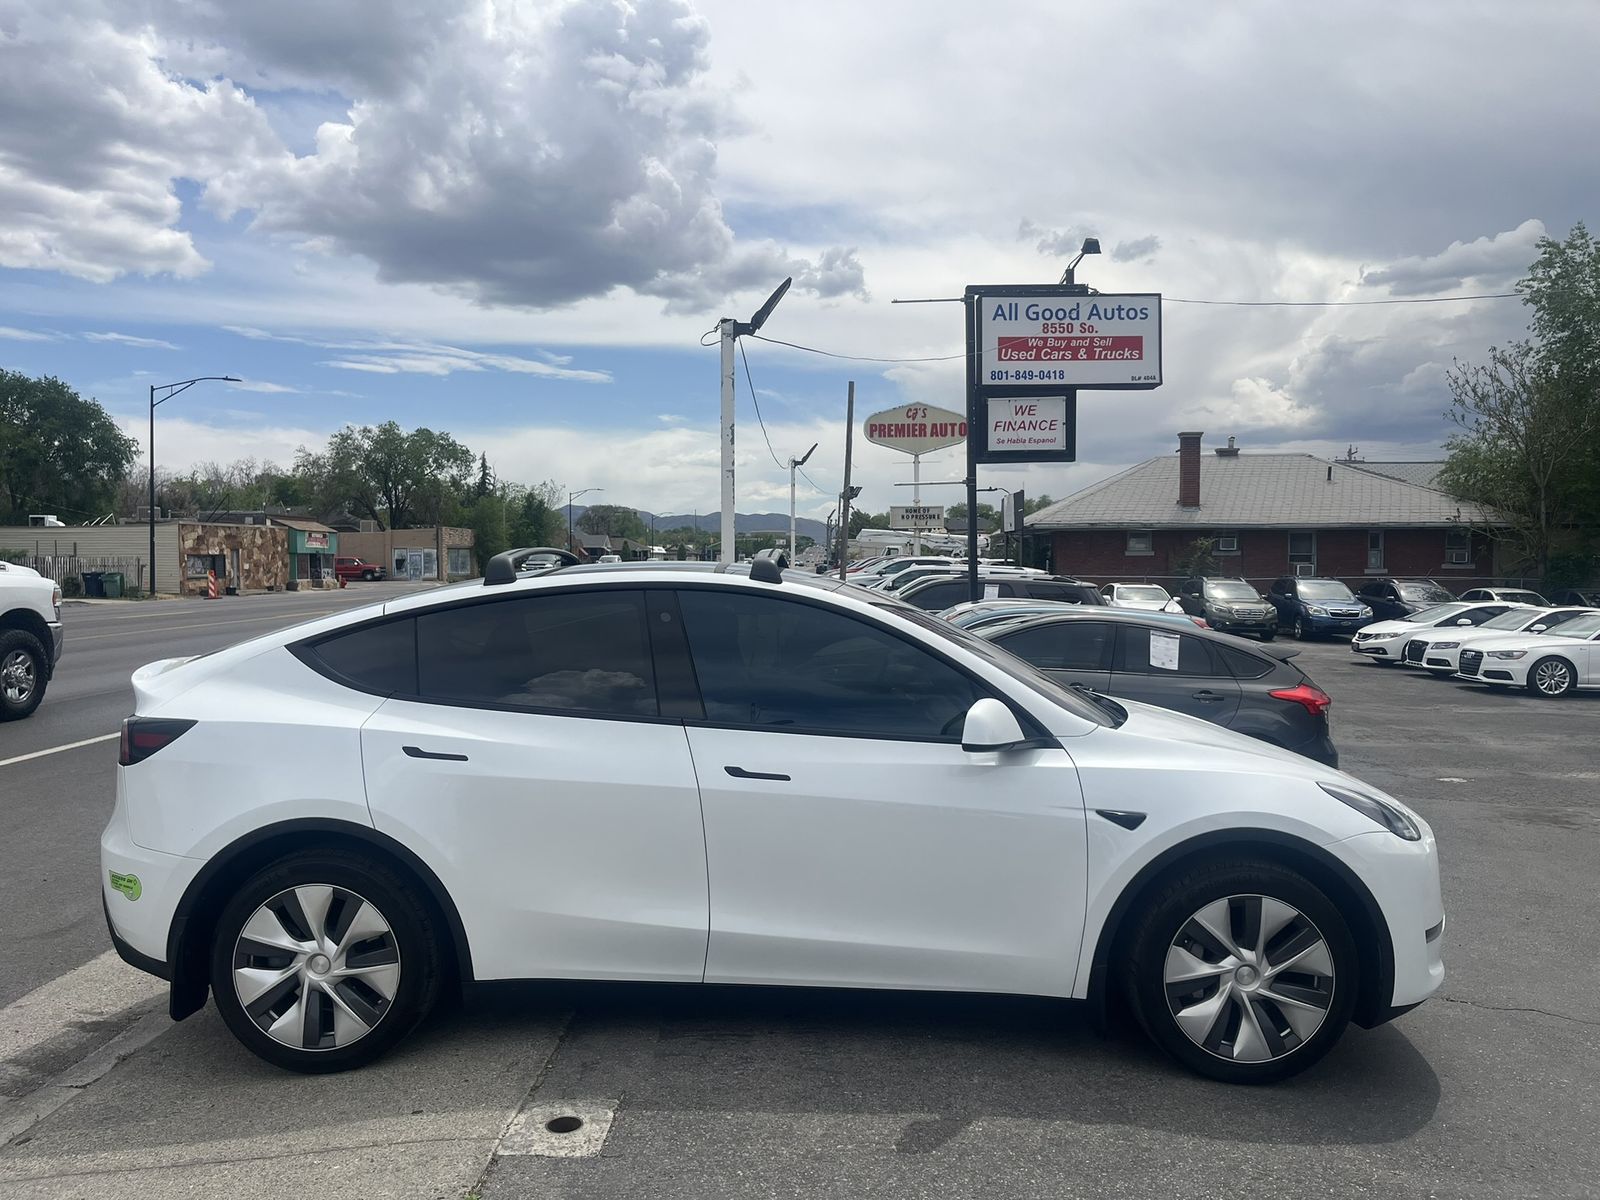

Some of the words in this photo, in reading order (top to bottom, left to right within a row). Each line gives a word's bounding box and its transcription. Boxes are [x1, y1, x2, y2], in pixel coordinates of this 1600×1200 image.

[992, 303, 1019, 321] All
[1025, 303, 1080, 321] Good
[1087, 303, 1149, 321] Autos
[1042, 322, 1074, 334] 8550
[1079, 322, 1099, 334] So.
[1028, 338, 1043, 347] We
[1047, 338, 1067, 349] Buy
[1070, 337, 1090, 347] and
[1093, 337, 1113, 347] Sell
[1001, 348, 1036, 360] Used
[1041, 348, 1072, 360] Cars
[1077, 348, 1088, 360] &
[1094, 347, 1140, 360] Trucks
[990, 369, 1065, 381] 801-849-0418
[1014, 404, 1037, 417] WE
[869, 423, 927, 438] PREMIER
[930, 422, 968, 438] AUTO
[993, 419, 1059, 432] FINANCE
[996, 437, 1005, 445] Se
[1006, 437, 1027, 445] Habla
[1028, 437, 1057, 445] Espanol
